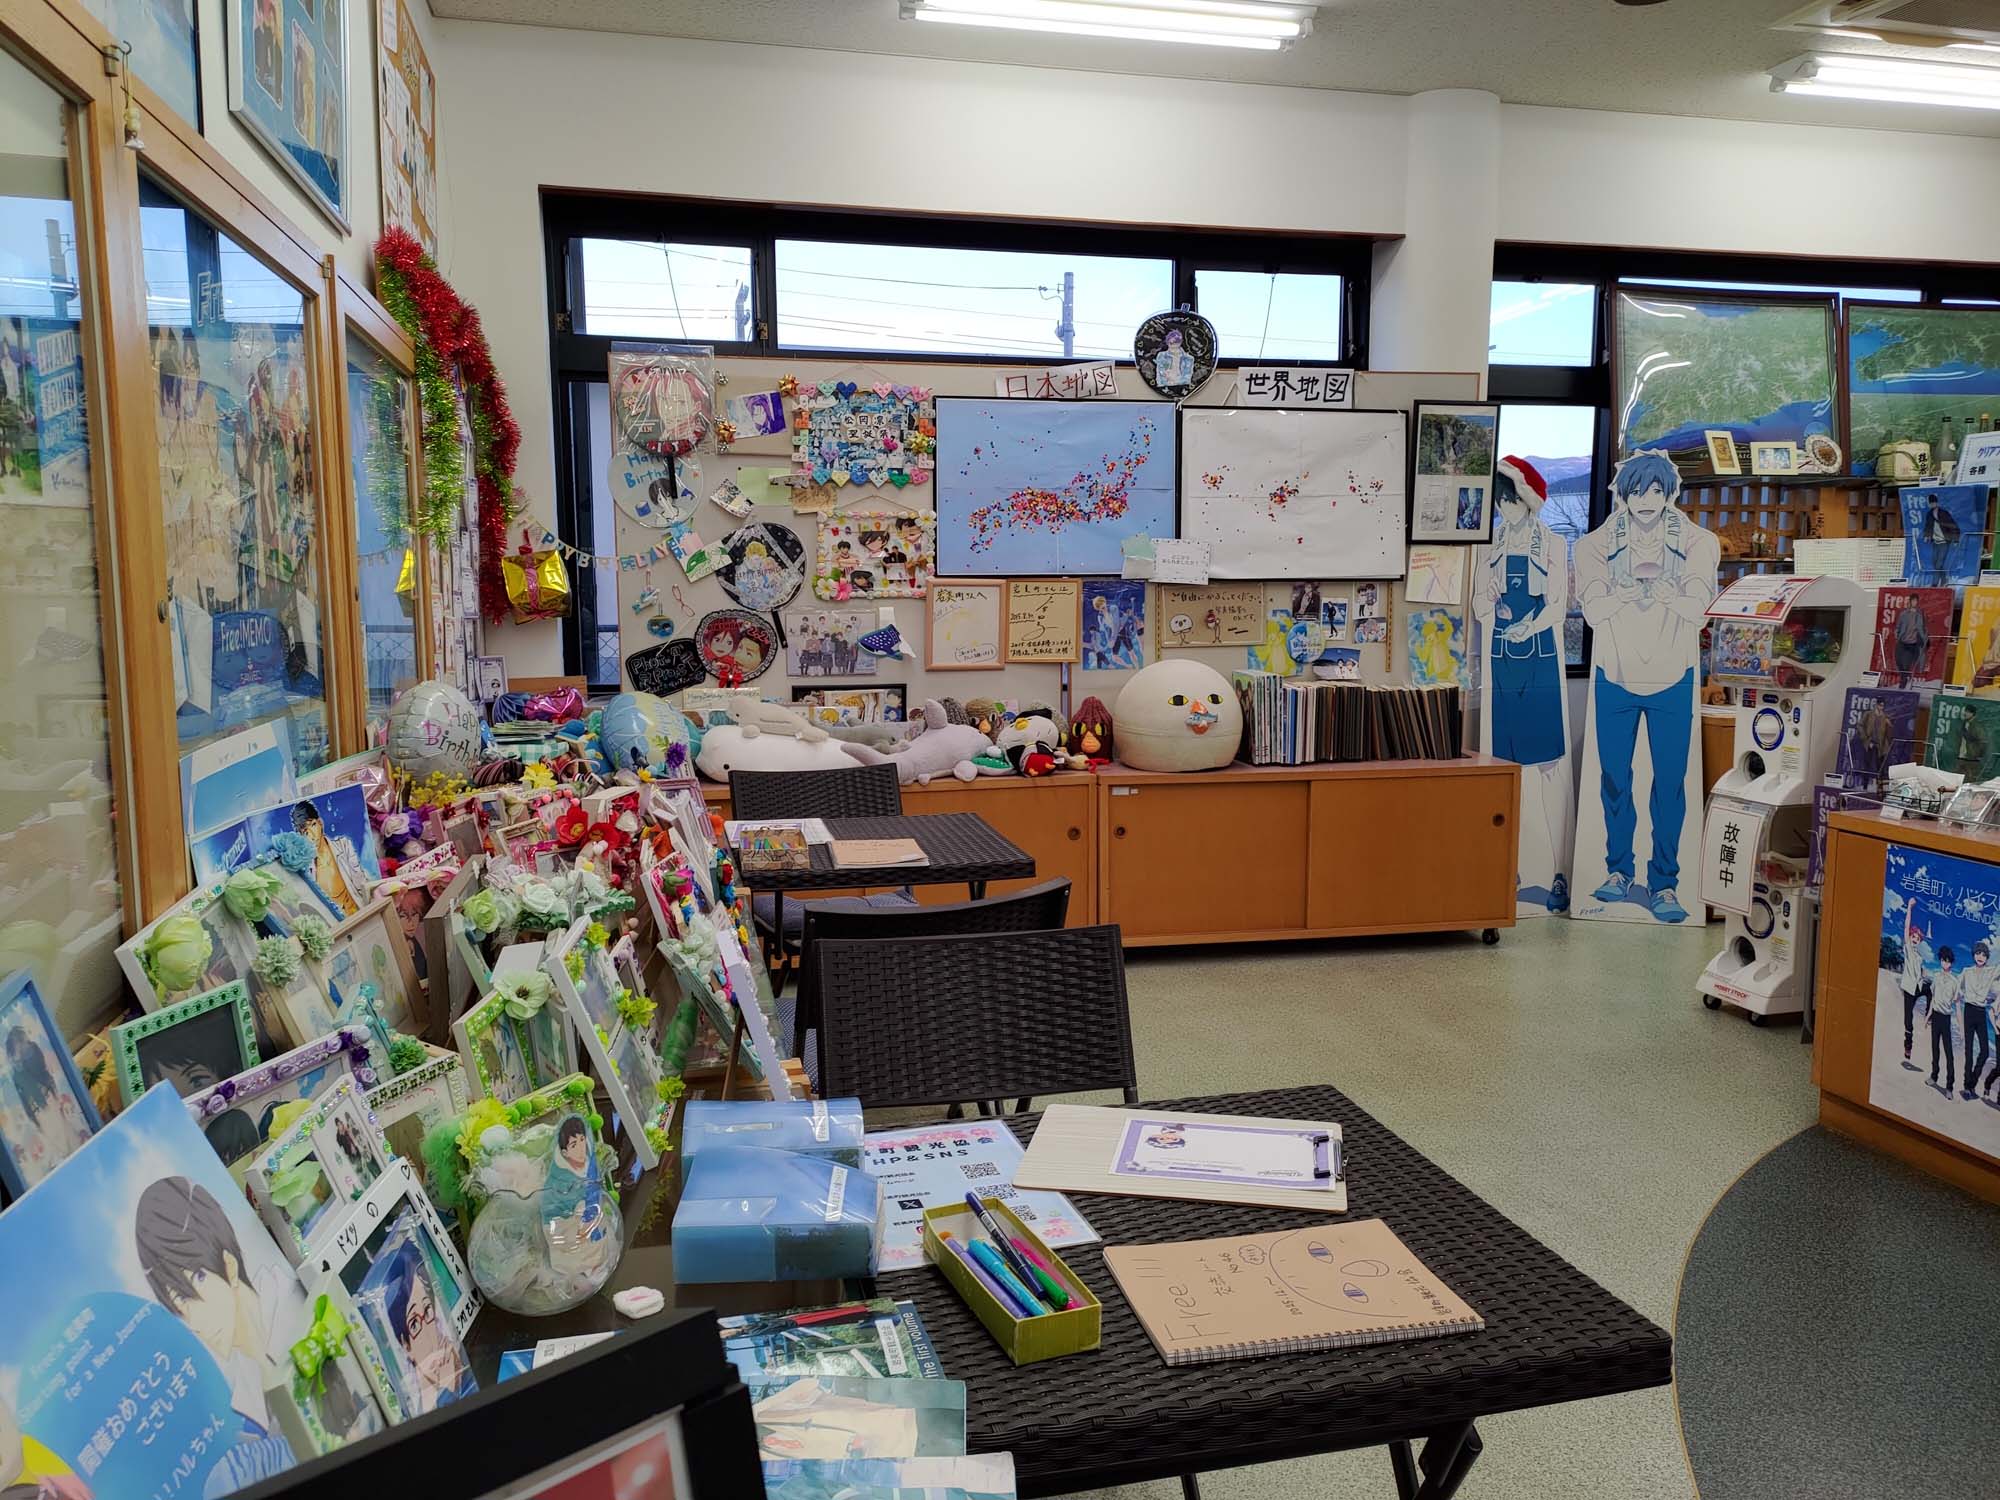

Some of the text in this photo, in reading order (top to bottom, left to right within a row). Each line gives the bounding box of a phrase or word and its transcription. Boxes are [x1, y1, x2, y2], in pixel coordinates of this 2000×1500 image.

[1006, 366, 1114, 399] 日本地図
[1246, 371, 1350, 402] 世界地図
[1969, 465, 1987, 476] 各種
[1720, 821, 1741, 888] 故障中
[1902, 873, 1946, 898] 岩美町
[1928, 900, 1952, 915] 2016
[416, 1193, 462, 1276] NAGISA
[903, 1312, 939, 1378] the first volume
[77, 1351, 171, 1478] 開催おめでとう
[136, 1356, 197, 1446] ございます
